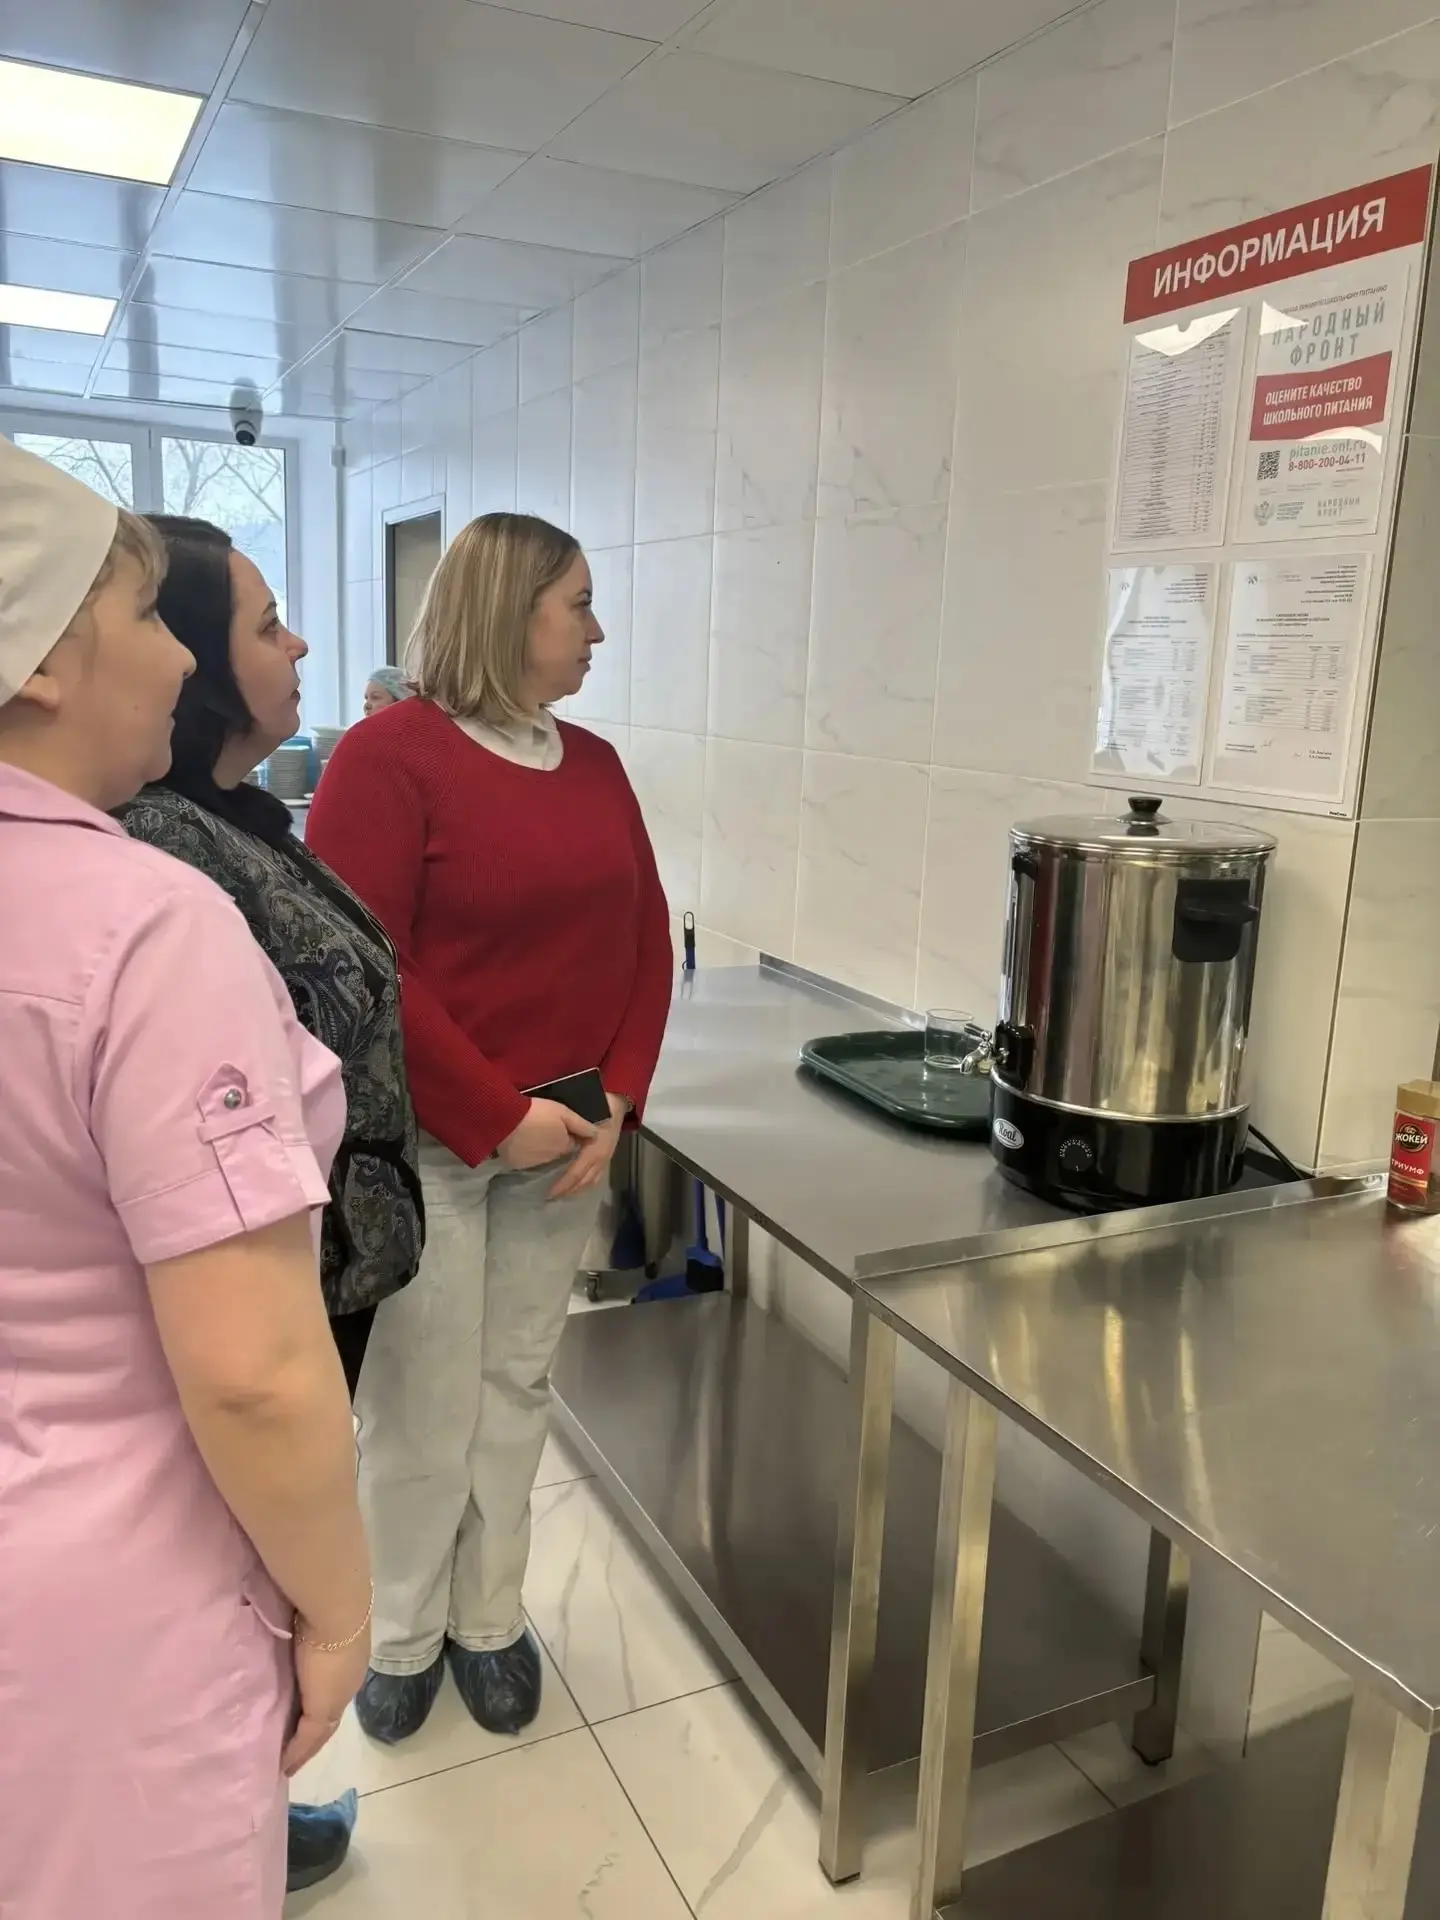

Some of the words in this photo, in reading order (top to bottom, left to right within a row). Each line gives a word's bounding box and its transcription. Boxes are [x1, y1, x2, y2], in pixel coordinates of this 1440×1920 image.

[1153, 197, 1386, 298] ИНФОРМАЦИЯ
[1290, 333, 1359, 366] ФРОНТ
[1265, 385, 1308, 406] ОЦЕНИТЕ
[1309, 376, 1362, 398] КАЧЕСТВО
[1263, 403, 1322, 426] ШКОЛЬНОГО
[1323, 395, 1373, 416] ПИТАНИЯ
[1288, 452, 1366, 471] 8-800-200-04-11
[1395, 1133, 1428, 1145] ЖОКЕЙ
[1391, 1159, 1424, 1175] ТРИУМФ
